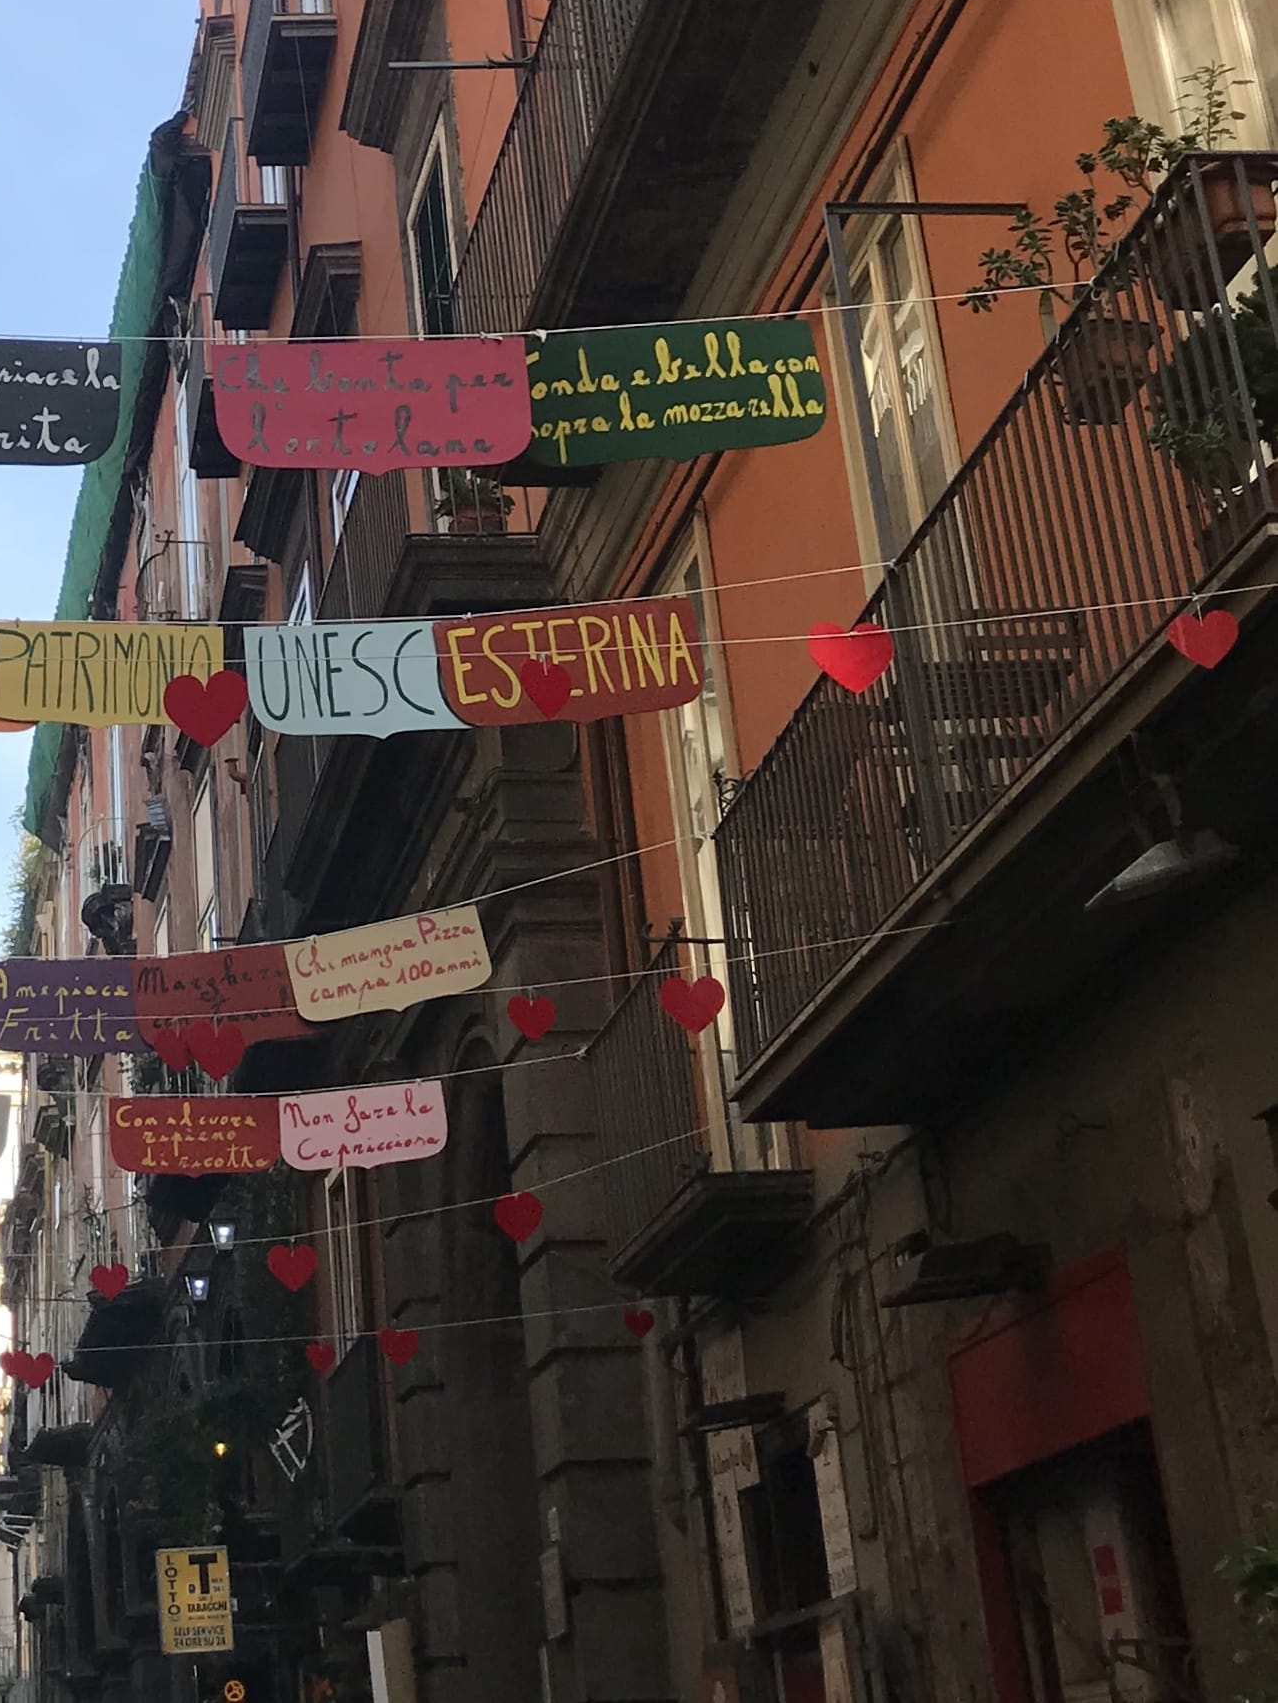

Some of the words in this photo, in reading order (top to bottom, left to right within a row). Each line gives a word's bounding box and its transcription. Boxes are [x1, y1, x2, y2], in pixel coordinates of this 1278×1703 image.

[83, 347, 121, 390] la
[216, 347, 290, 394] Che
[445, 370, 513, 414] per
[630, 367, 650, 386] e
[654, 330, 769, 385] bella
[774, 353, 820, 374] con
[619, 390, 655, 432] la
[663, 373, 824, 427] mozzarella
[258, 628, 436, 721] UNESC
[446, 611, 700, 708] ESTERINA
[295, 942, 335, 978] Chi
[341, 938, 417, 969] mangia
[417, 916, 475, 945] Pizza
[310, 979, 390, 1010] campa
[396, 960, 433, 985] 100
[435, 951, 483, 975] anni
[115, 1105, 158, 1128] Con
[199, 1115, 257, 1128] cuore
[283, 1102, 334, 1128] Non
[344, 1095, 398, 1133] fare
[404, 1088, 433, 1117] la
[141, 1147, 169, 1167] di
[178, 1144, 269, 1169] ricotta
[142, 1128, 237, 1157] ripieno
[165, 1555, 181, 1615] LOTTO
[187, 1601, 227, 1613] TABACCHI
